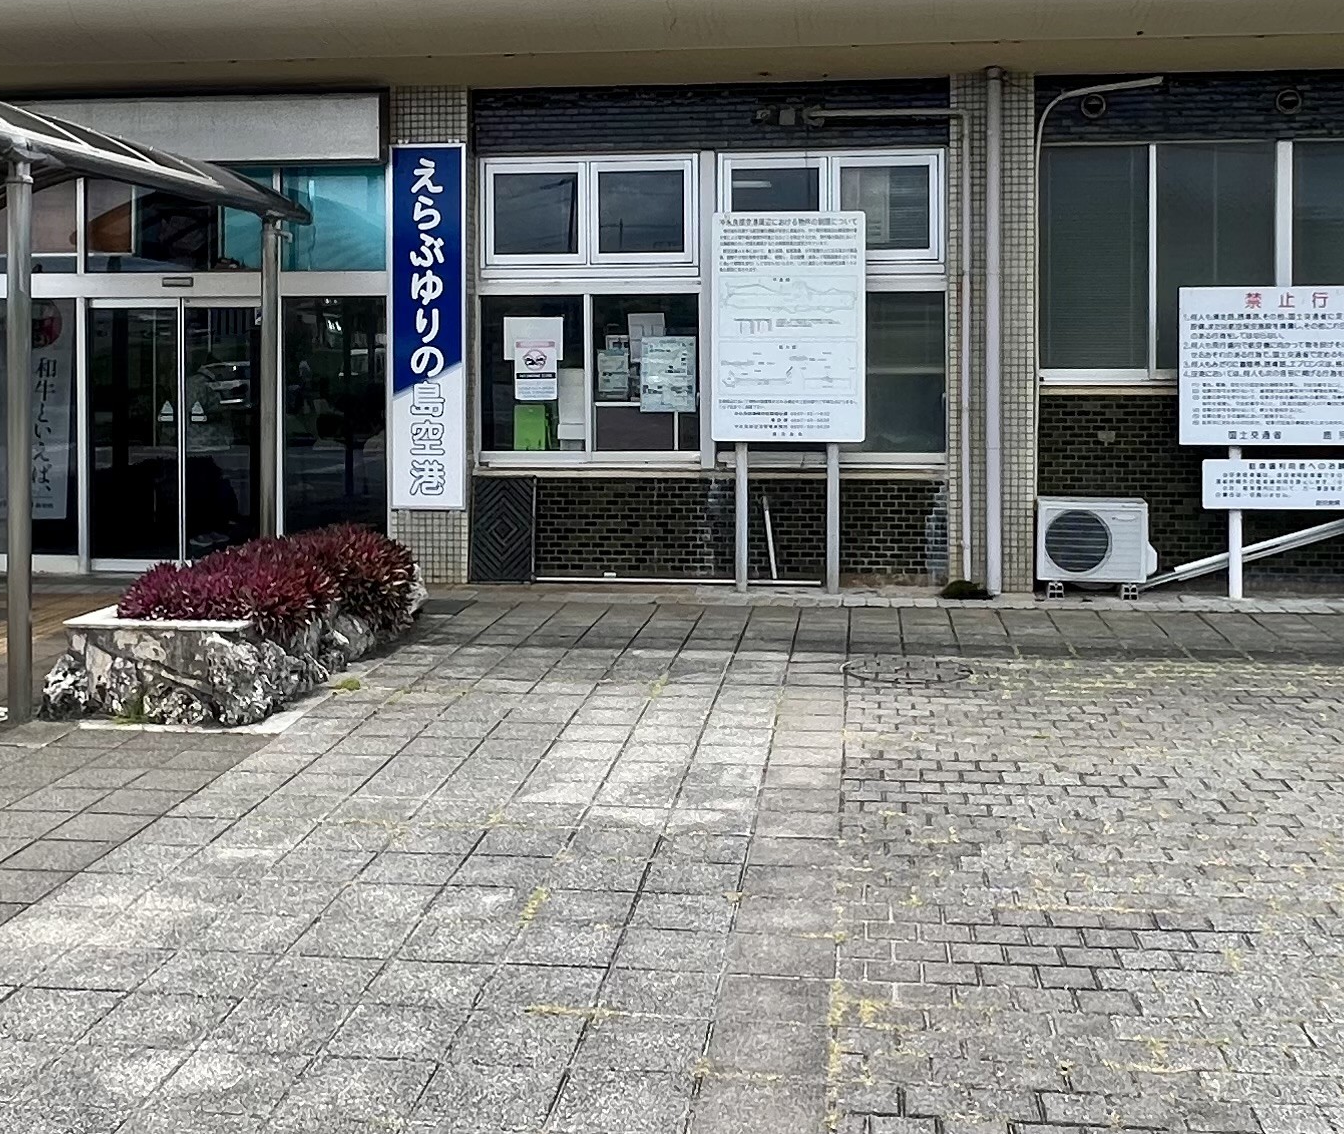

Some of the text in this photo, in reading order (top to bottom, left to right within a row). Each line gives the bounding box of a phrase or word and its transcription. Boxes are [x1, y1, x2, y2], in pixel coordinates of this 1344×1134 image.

[410, 157, 445, 496] えらぶゆりの島空港
